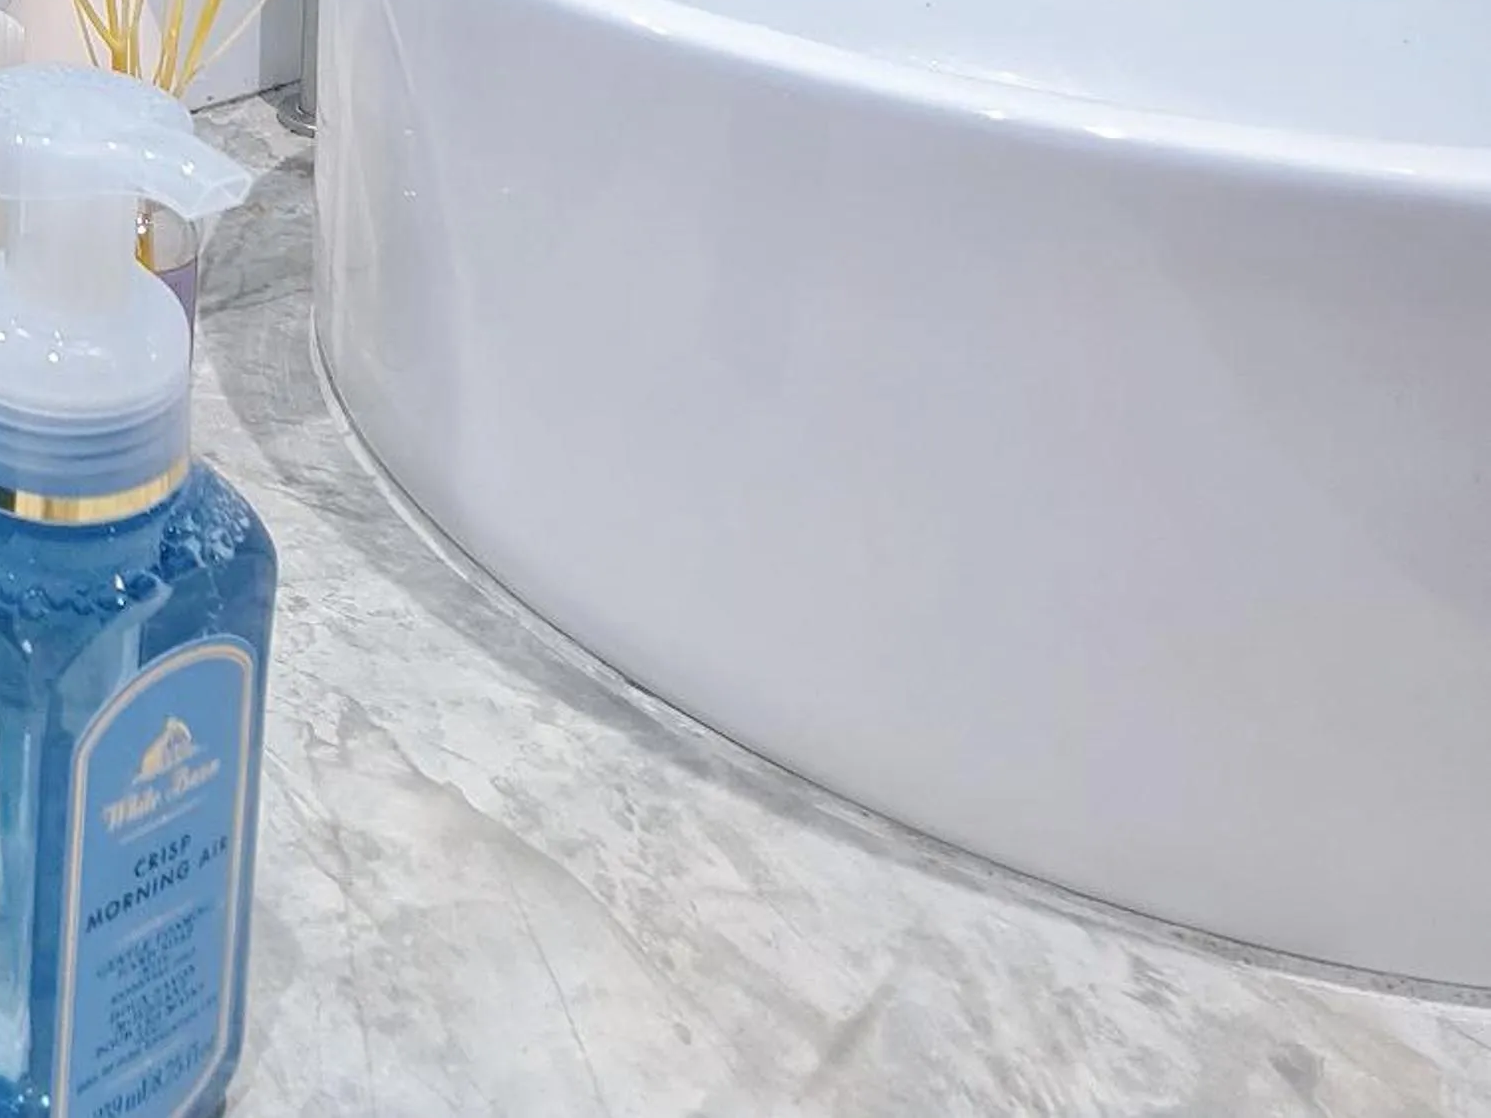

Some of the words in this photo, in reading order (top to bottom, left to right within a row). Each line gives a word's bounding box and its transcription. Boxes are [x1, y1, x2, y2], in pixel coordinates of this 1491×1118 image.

[85, 859, 190, 933] MORNING
[198, 835, 228, 870] AIR
[133, 834, 192, 878] CRISP
